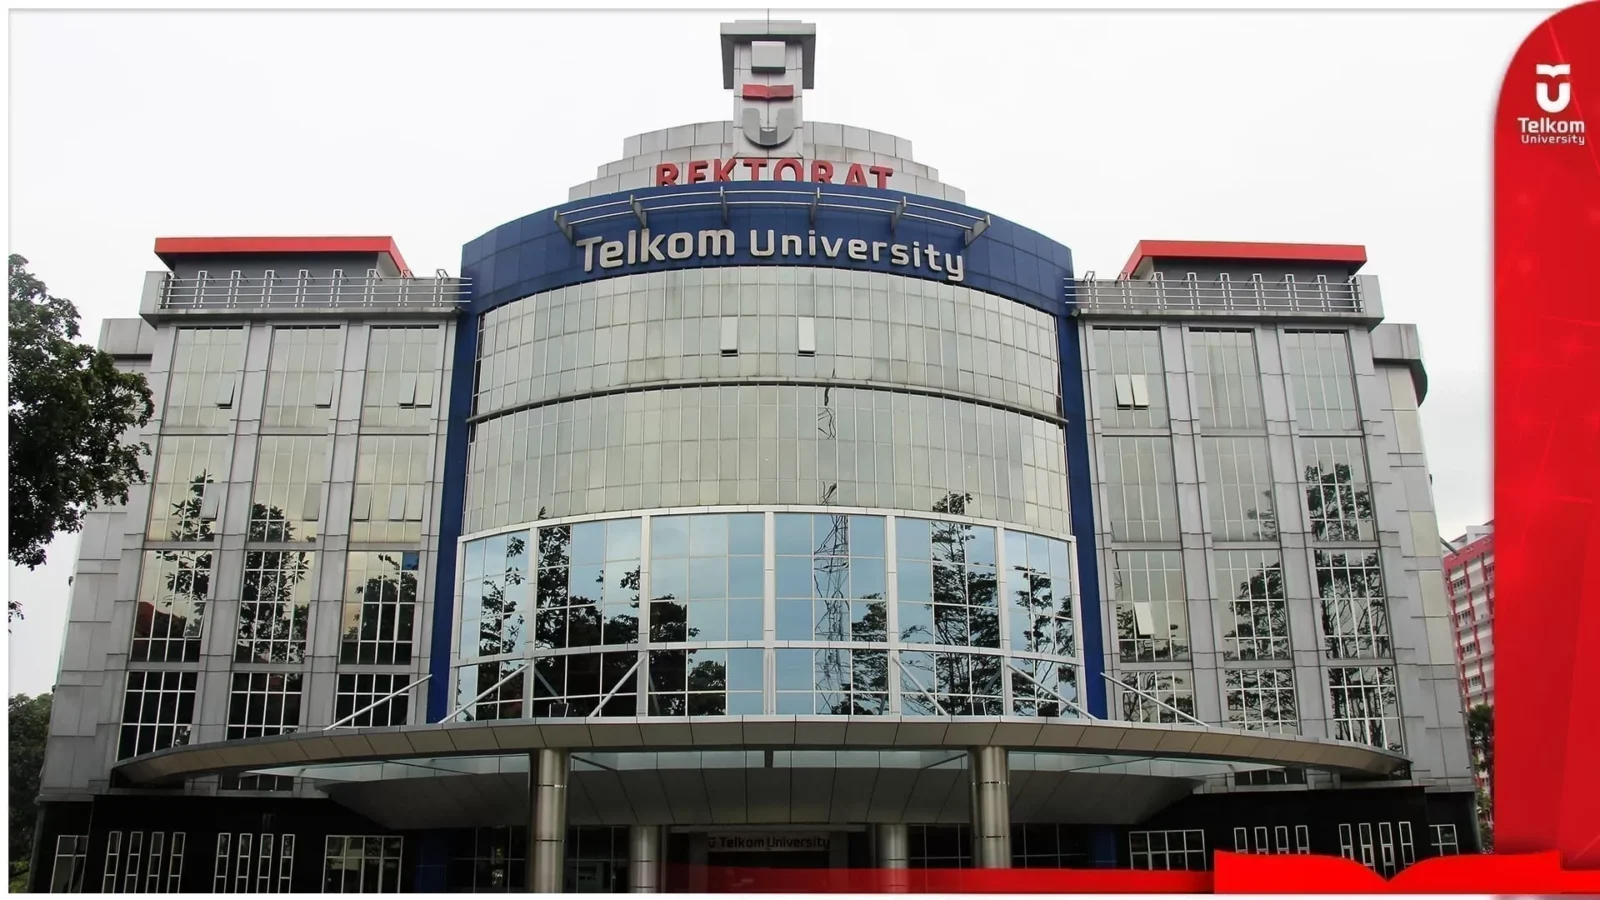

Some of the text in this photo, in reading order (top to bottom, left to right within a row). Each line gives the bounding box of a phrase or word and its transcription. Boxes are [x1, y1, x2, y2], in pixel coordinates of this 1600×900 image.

[576, 228, 965, 282] Telkom University
[719, 836, 830, 849] Telkom University
